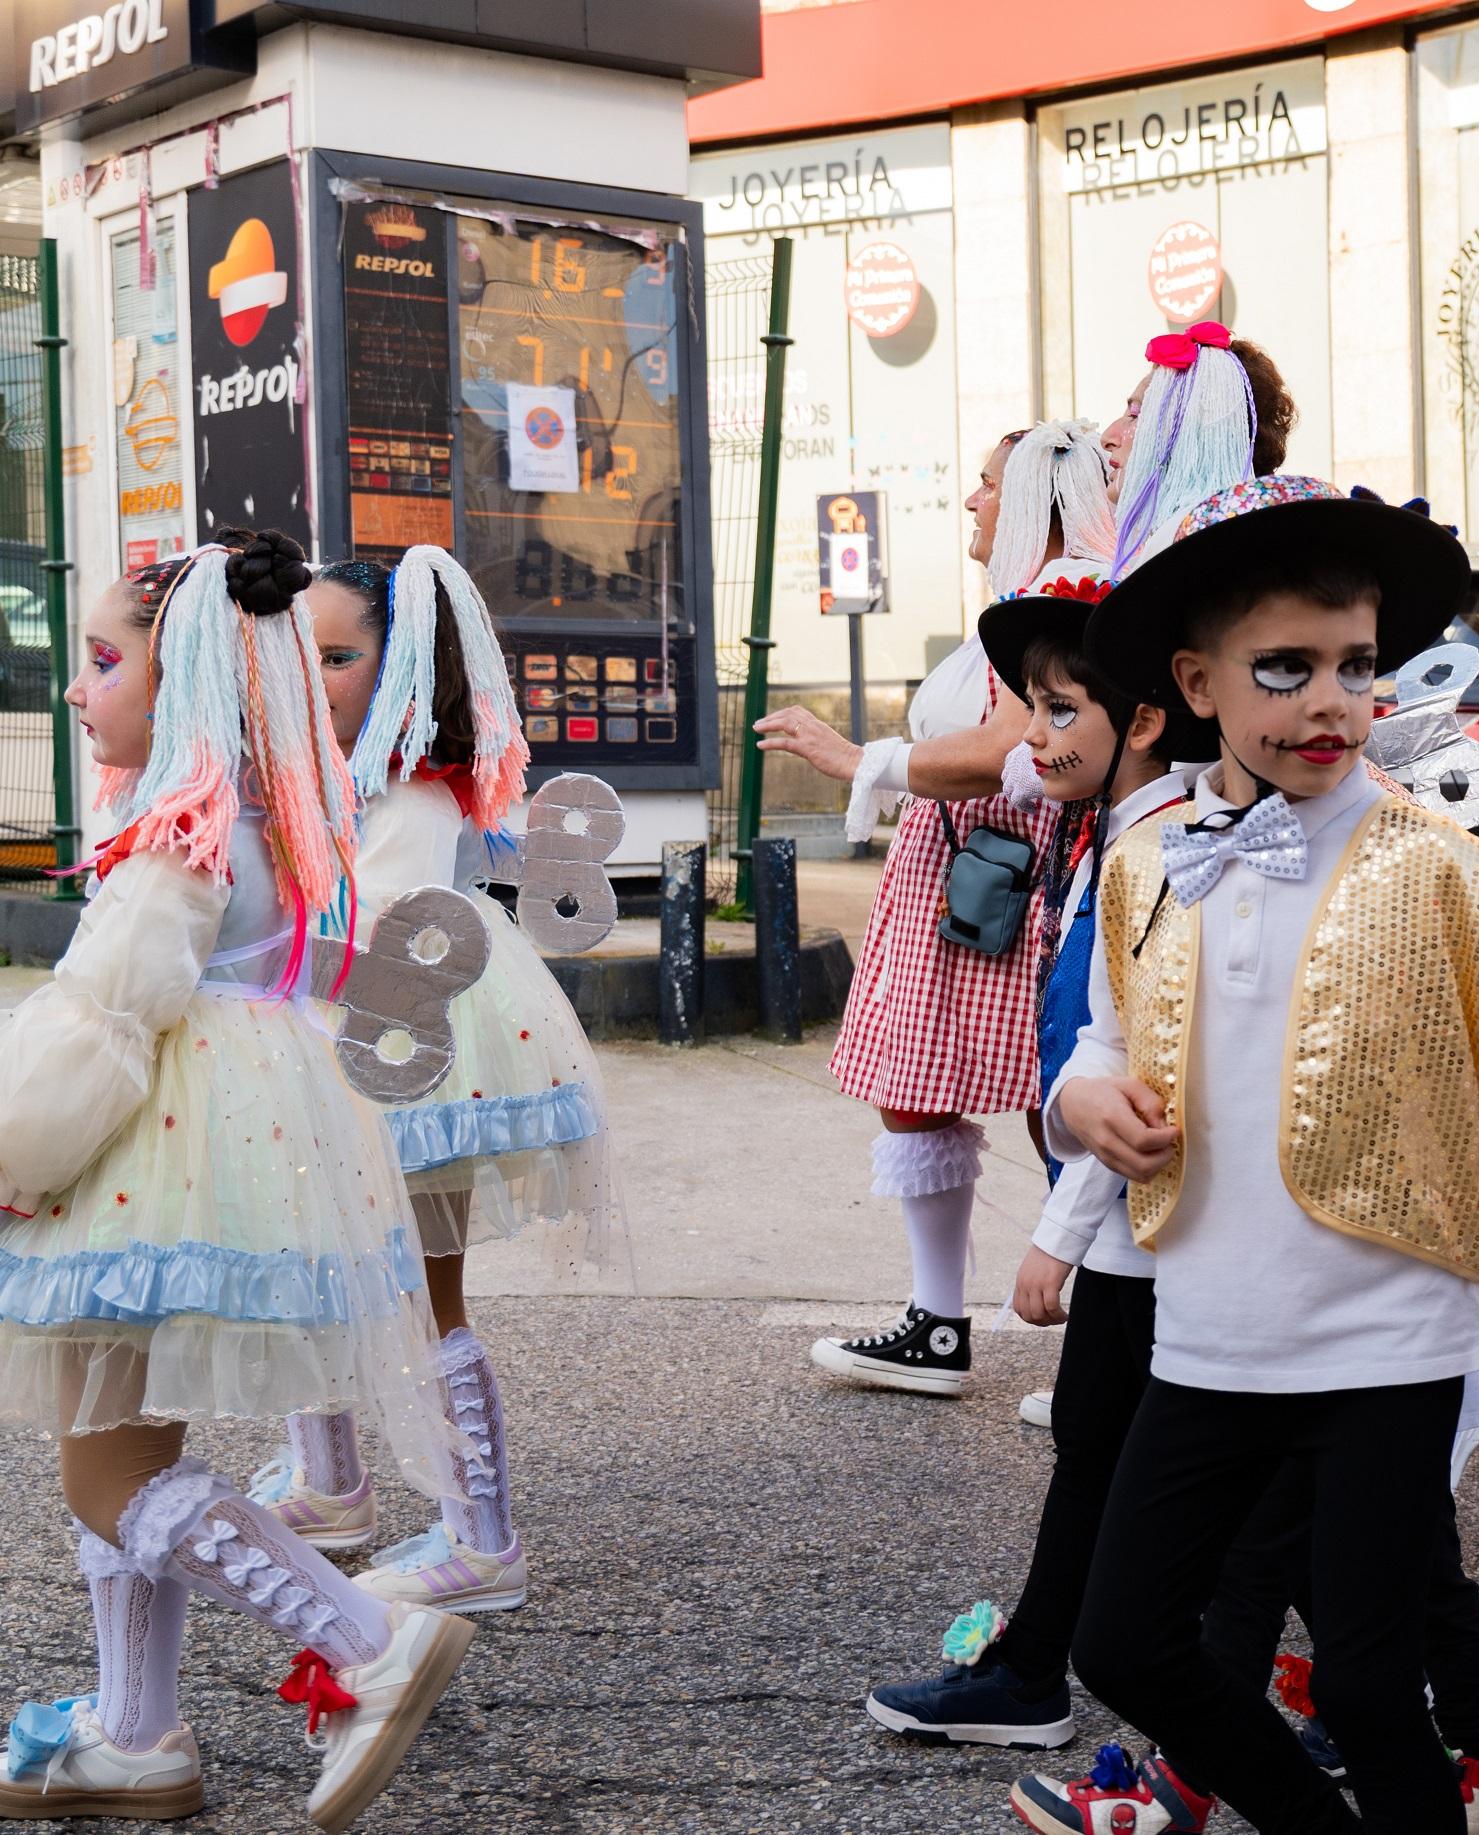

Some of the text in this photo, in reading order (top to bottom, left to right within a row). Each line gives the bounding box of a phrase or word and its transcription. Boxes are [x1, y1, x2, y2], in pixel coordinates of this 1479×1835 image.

[29, 0, 168, 92] REPSOL
[1065, 83, 1294, 164] RELOJERÍA
[719, 149, 893, 210] JOYERÍA
[354, 254, 435, 278] REPSOL
